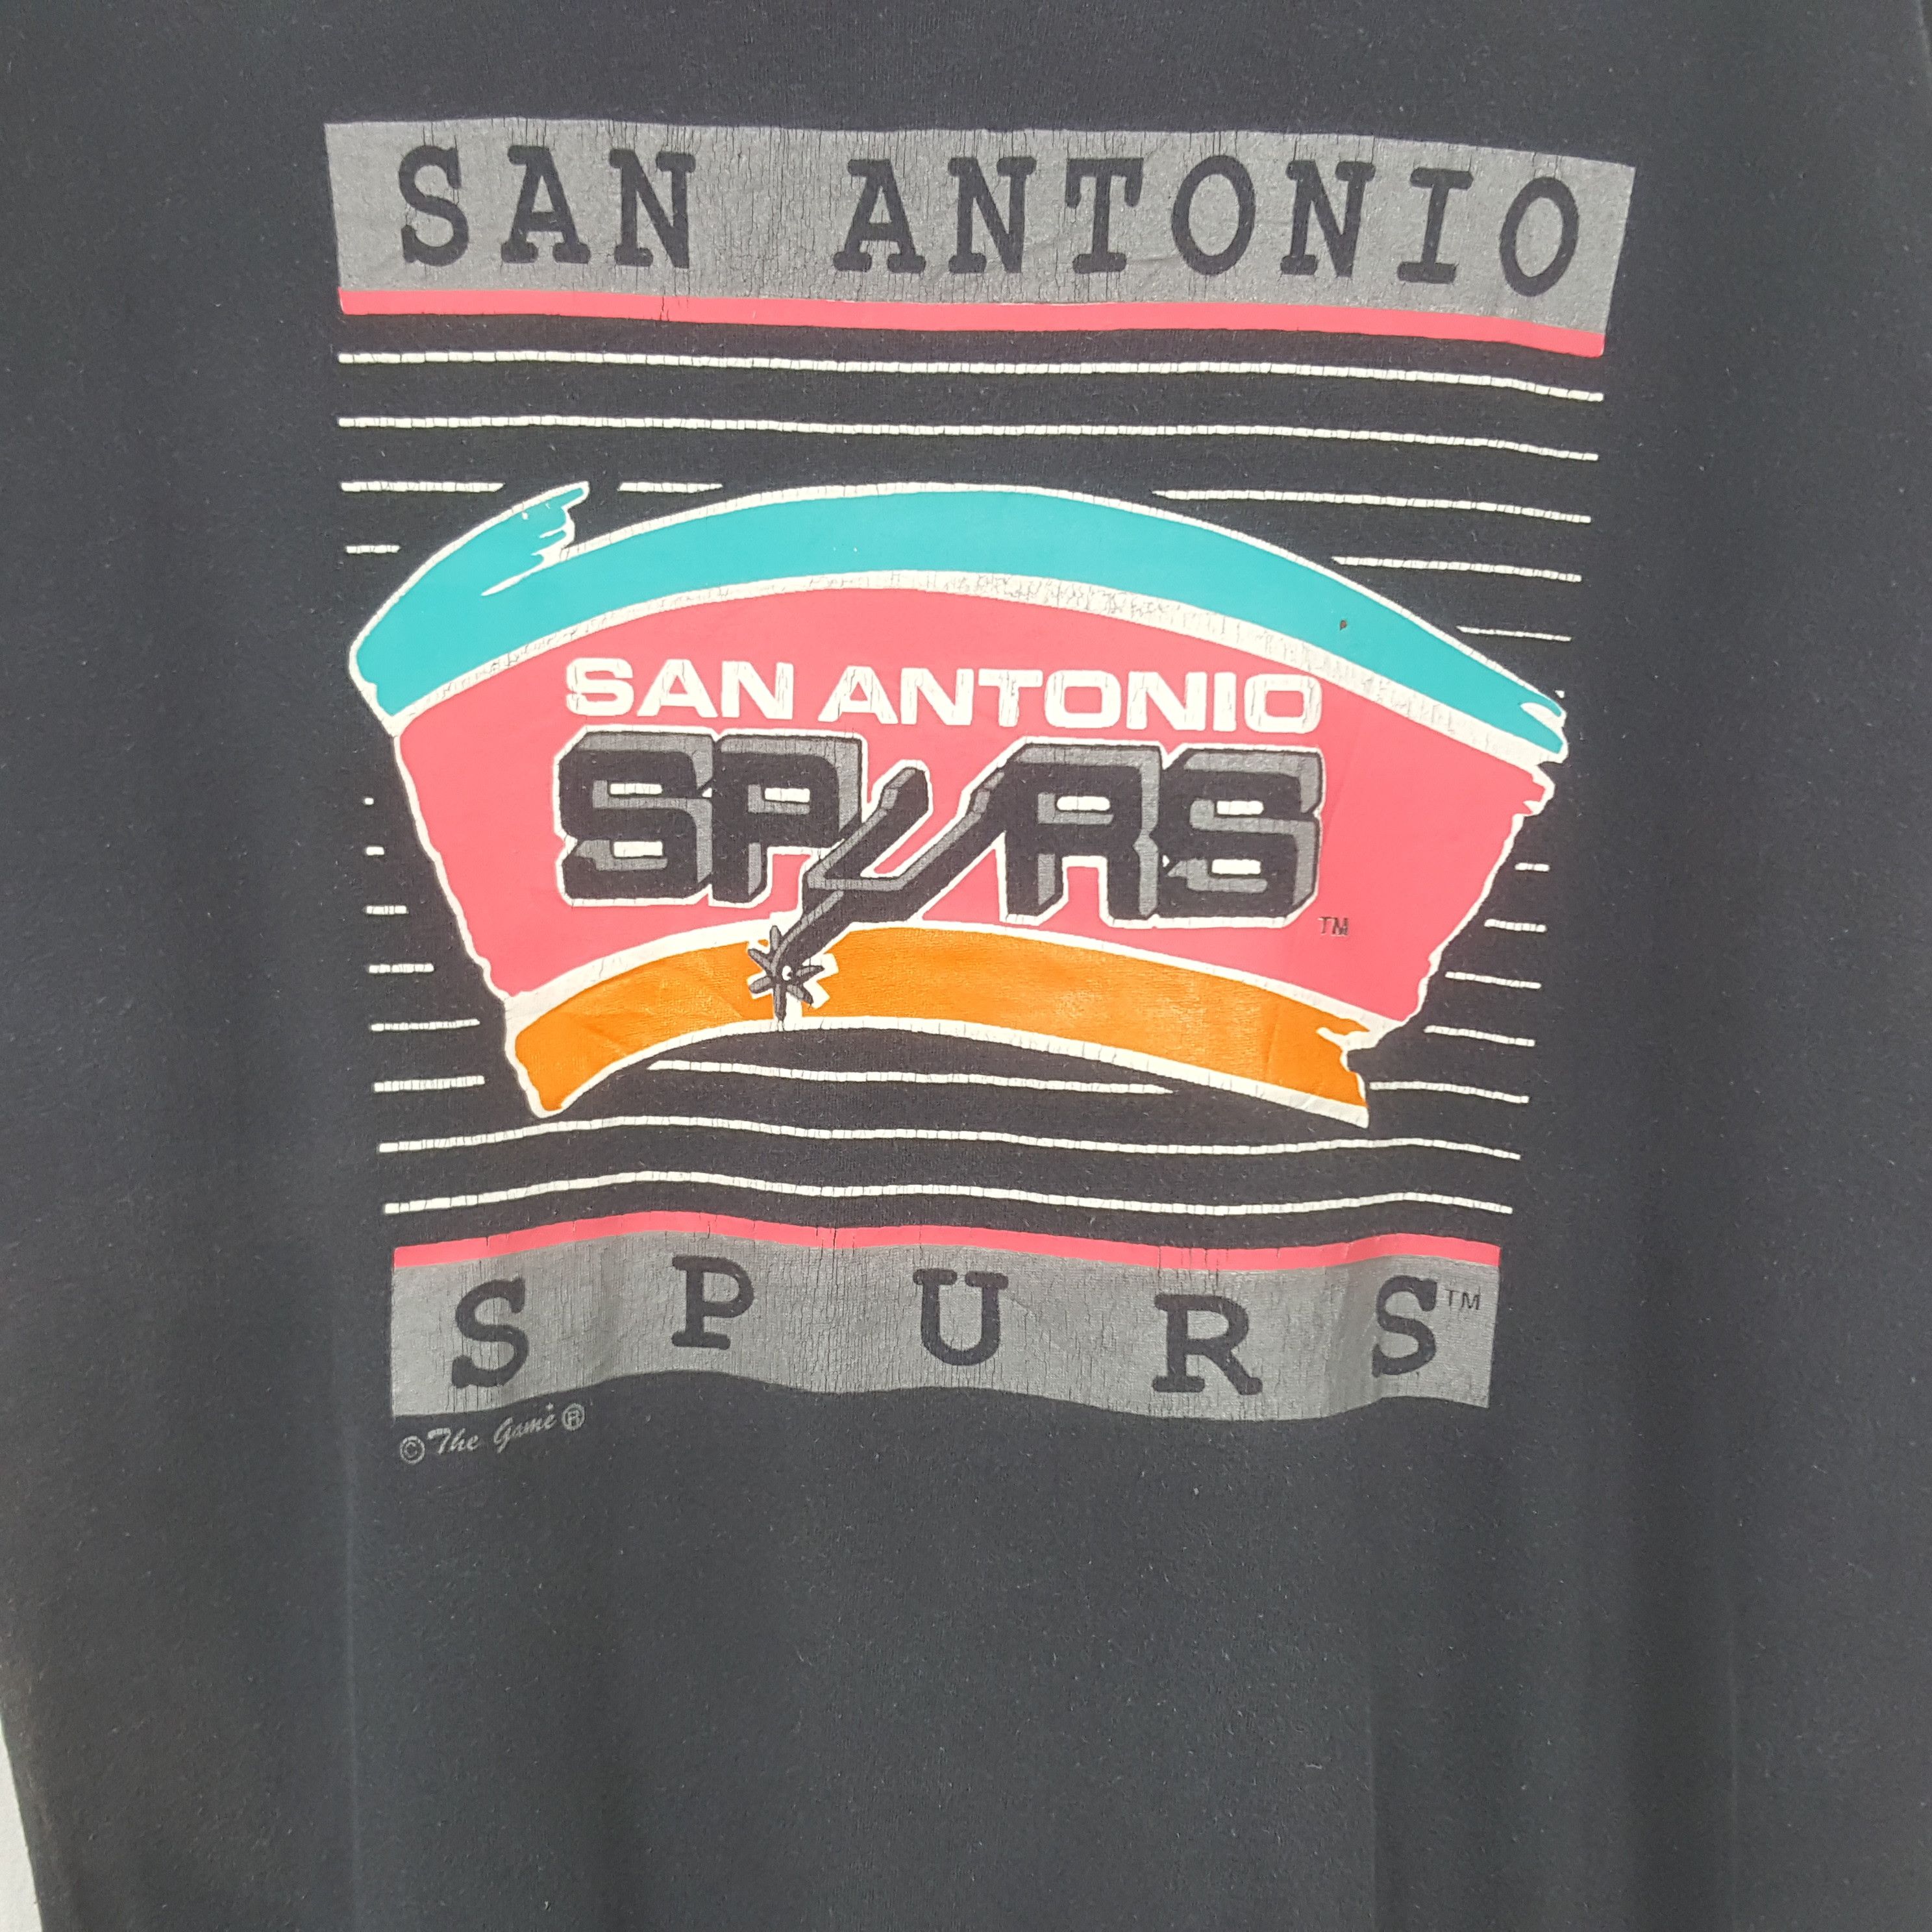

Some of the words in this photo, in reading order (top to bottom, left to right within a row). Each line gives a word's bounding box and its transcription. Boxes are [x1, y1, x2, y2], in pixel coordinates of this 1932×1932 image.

[399, 145, 695, 268] SAN
[832, 155, 1579, 297] ANTONIO
[564, 657, 795, 719] SAN
[818, 665, 1322, 734] ANTONIO
[552, 725, 1324, 930] SPURS
[1319, 916, 1349, 936] TM
[451, 1255, 1437, 1396] SPURS
